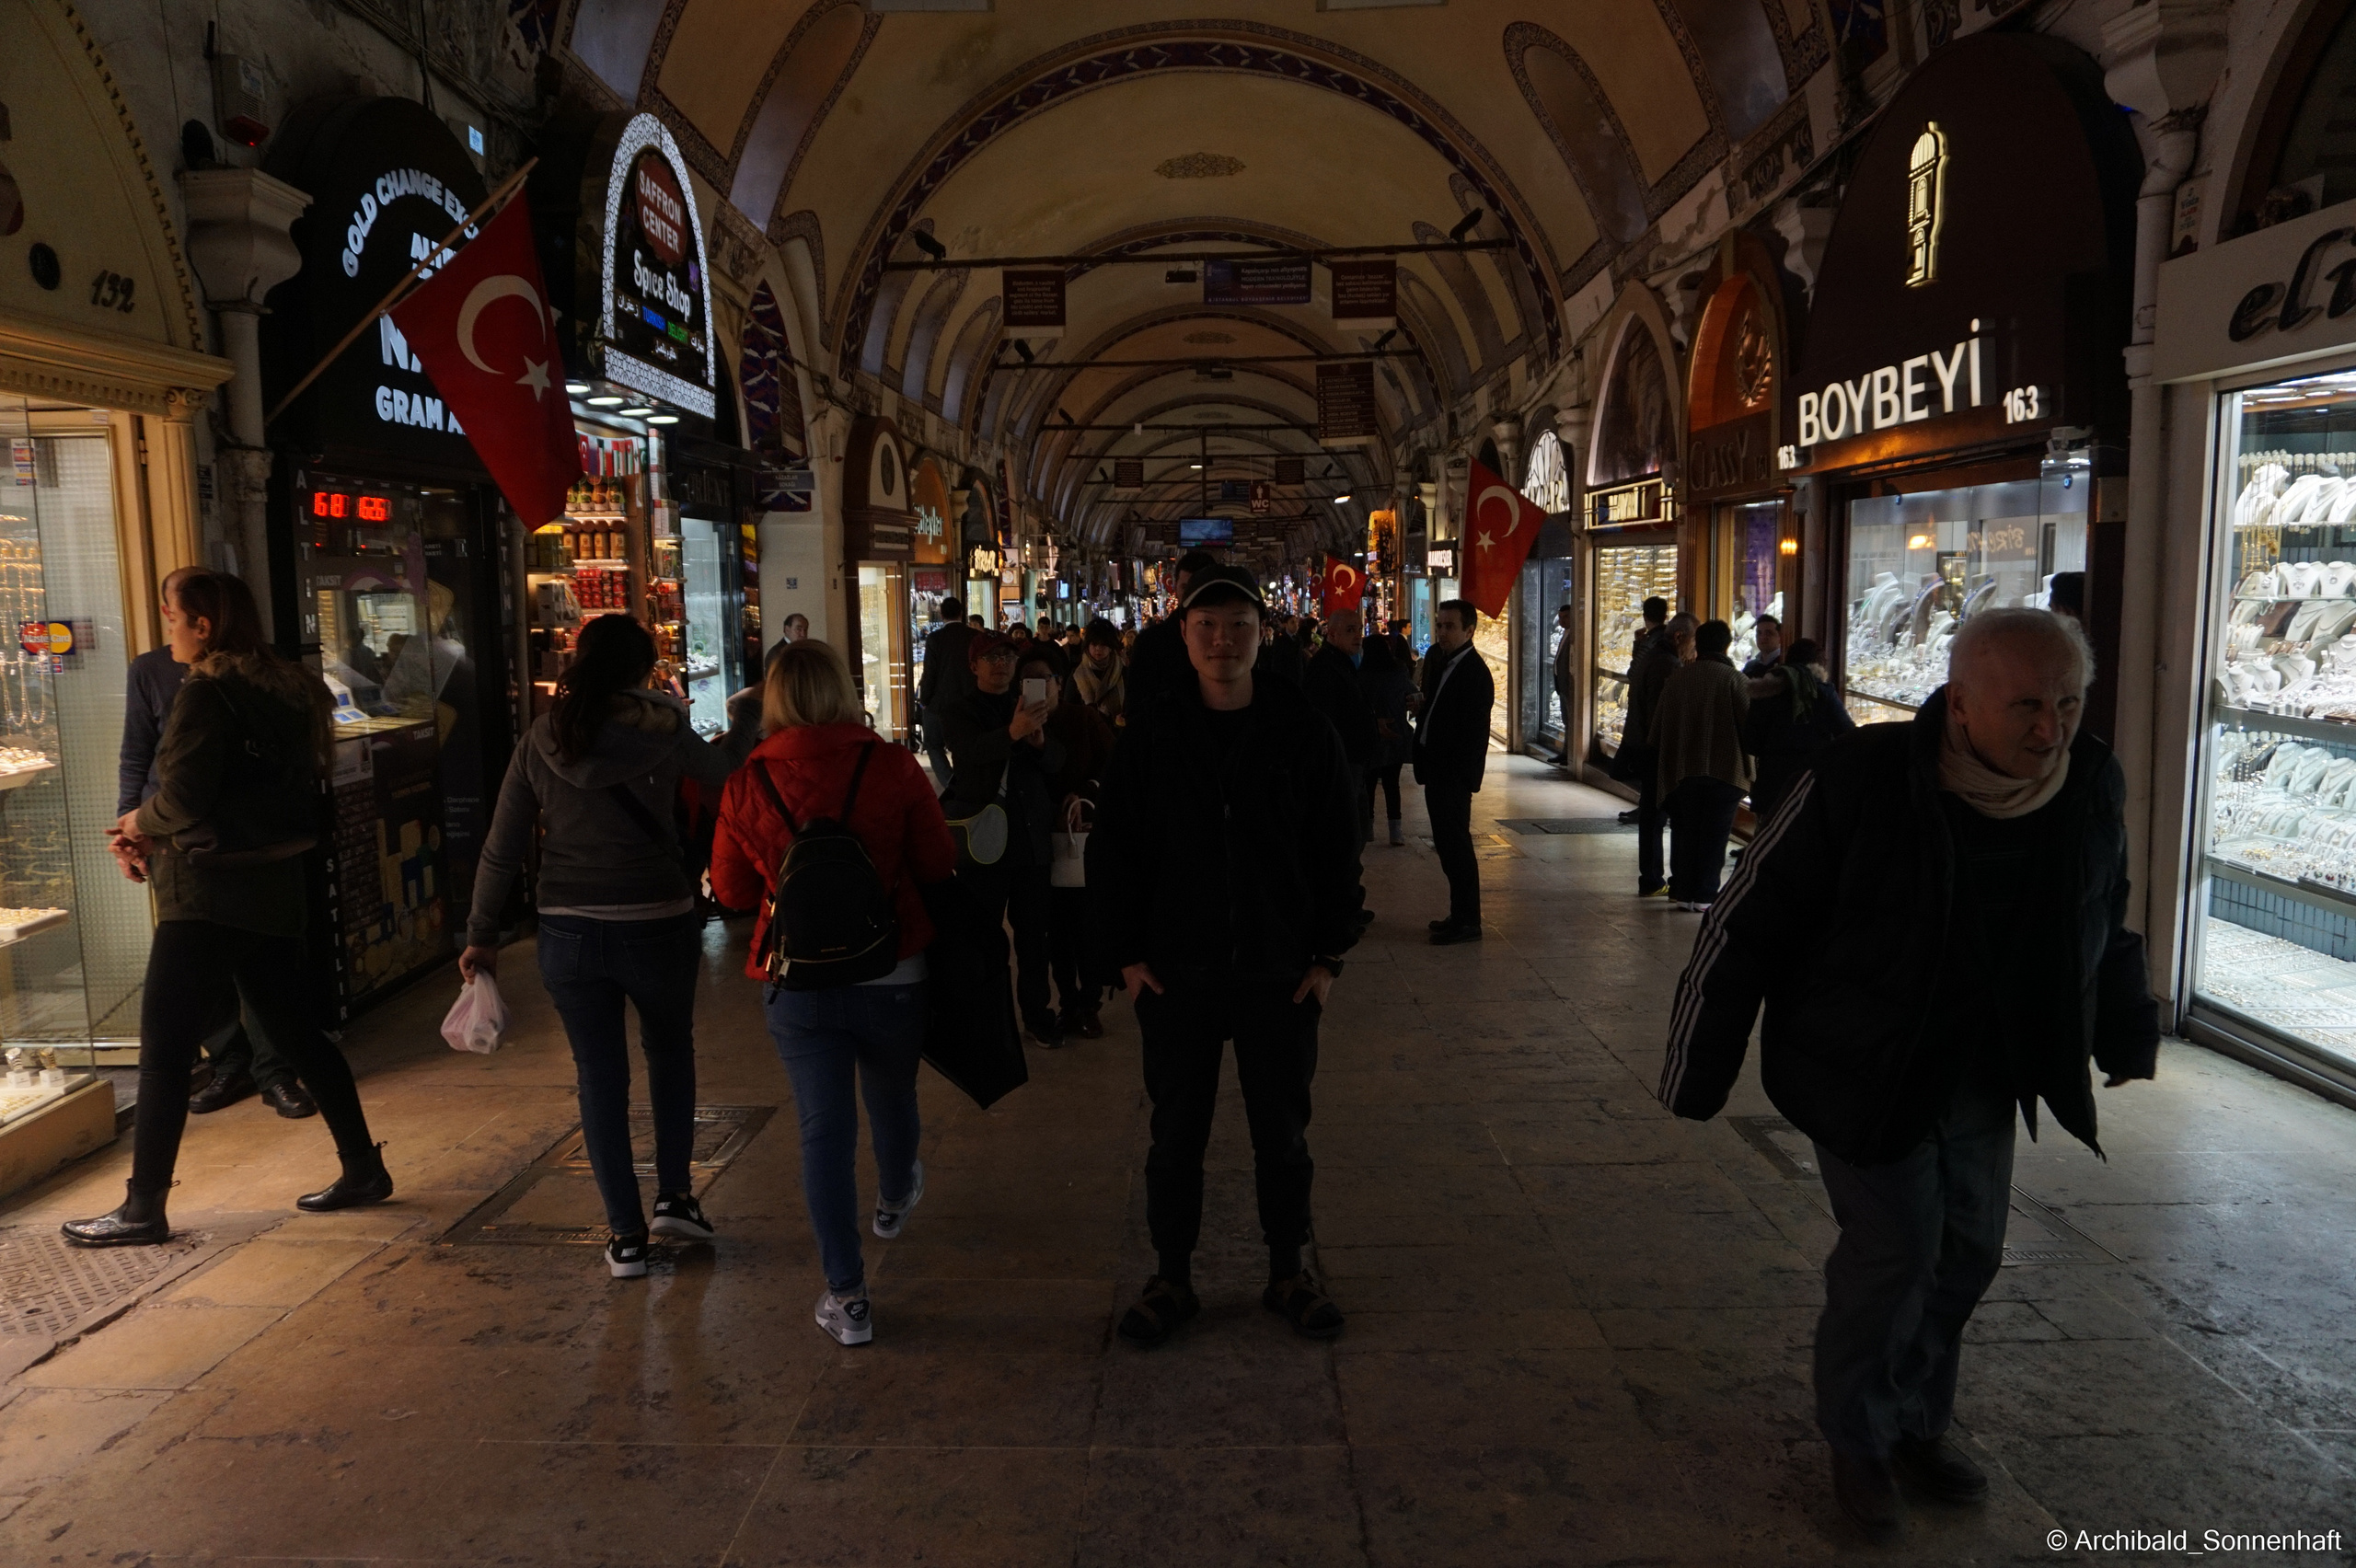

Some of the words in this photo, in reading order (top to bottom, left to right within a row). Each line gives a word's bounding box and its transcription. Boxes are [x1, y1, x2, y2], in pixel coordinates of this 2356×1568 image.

[639, 169, 681, 226] SAFFRON
[342, 192, 377, 278] GOLD
[375, 168, 443, 206] CHANGE
[642, 205, 678, 254] CENTER
[92, 270, 135, 313] 132
[634, 248, 664, 300] Spice
[666, 271, 691, 323] Shop
[1799, 318, 1981, 447] BOYBEYİ
[2003, 366, 2038, 424] 163
[375, 385, 444, 432] GRAM
[1690, 429, 1750, 491] CLASSY
[1777, 444, 1796, 470] 163
[1251, 500, 1269, 508] WC
[654, 1201, 672, 1211] NIKE
[620, 1247, 639, 1258] NIKE
